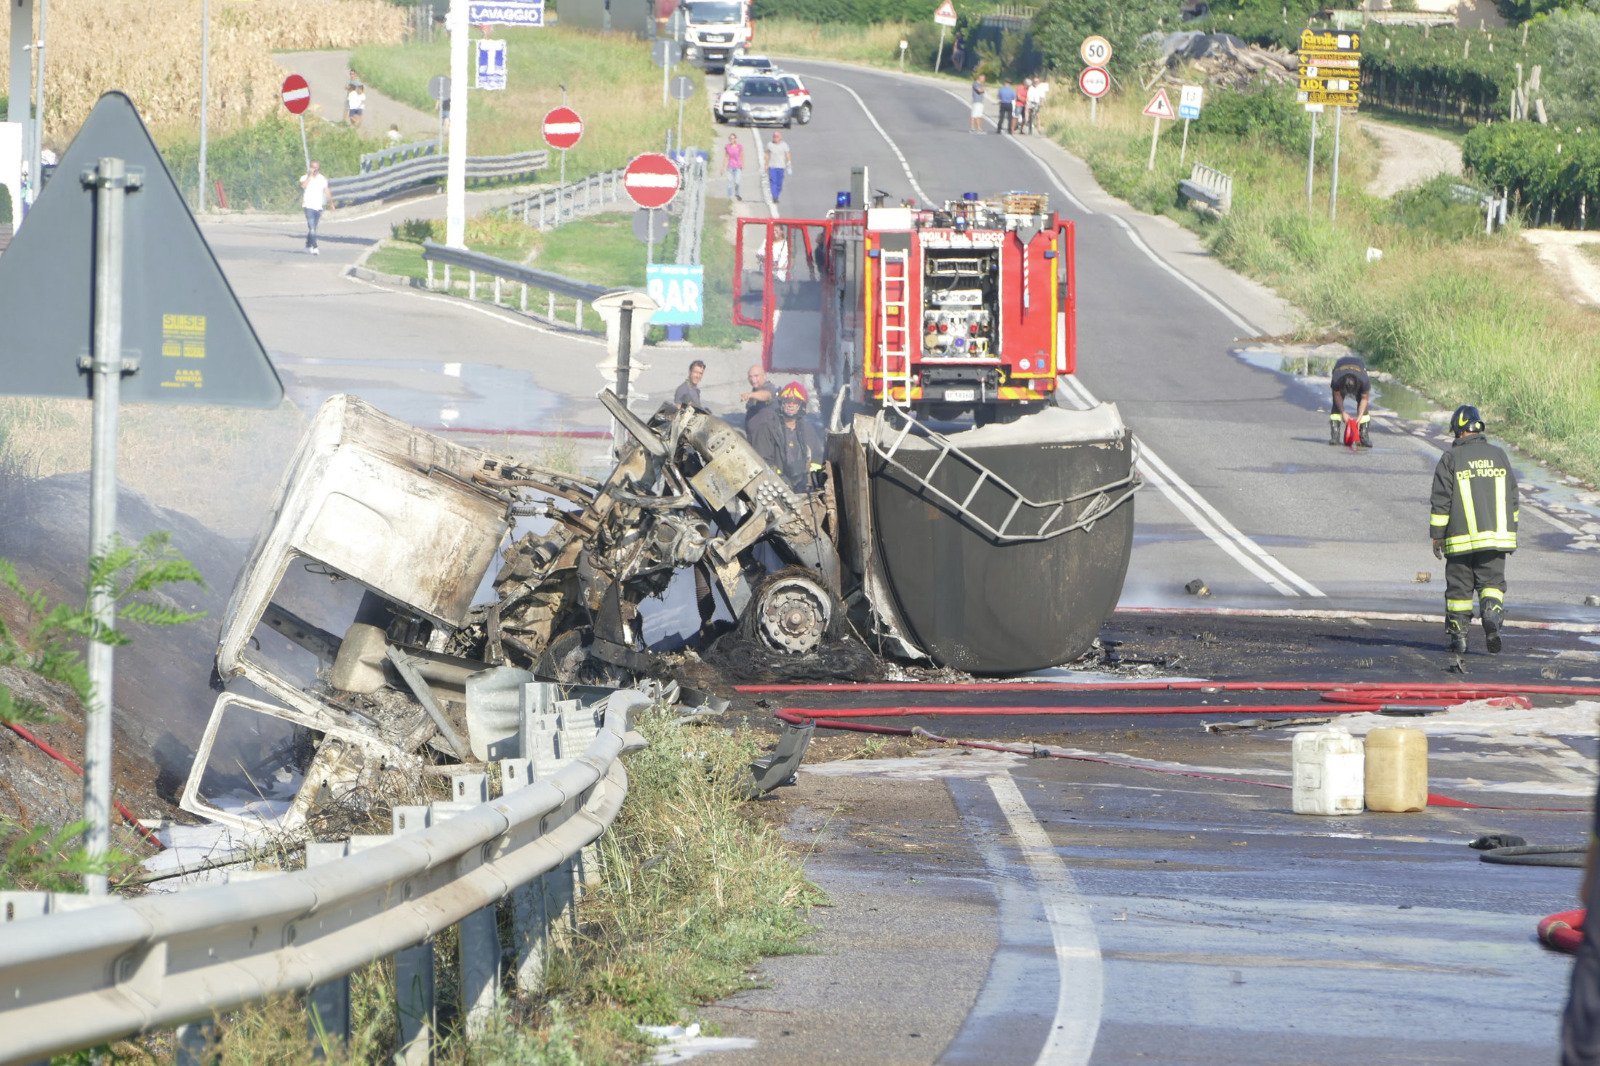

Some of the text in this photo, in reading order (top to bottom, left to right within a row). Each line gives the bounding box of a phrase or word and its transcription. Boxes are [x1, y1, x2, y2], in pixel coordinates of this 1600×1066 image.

[471, 7, 539, 22] LAVAGGIO
[1088, 45, 1104, 58] 50
[1300, 79, 1325, 91] LIDL
[919, 231, 947, 242] VIGILI
[972, 232, 1005, 243] FUOCO
[648, 278, 699, 312] BAR
[1468, 459, 1494, 469] VIGILI
[1456, 468, 1507, 480] DEL FUOCO
